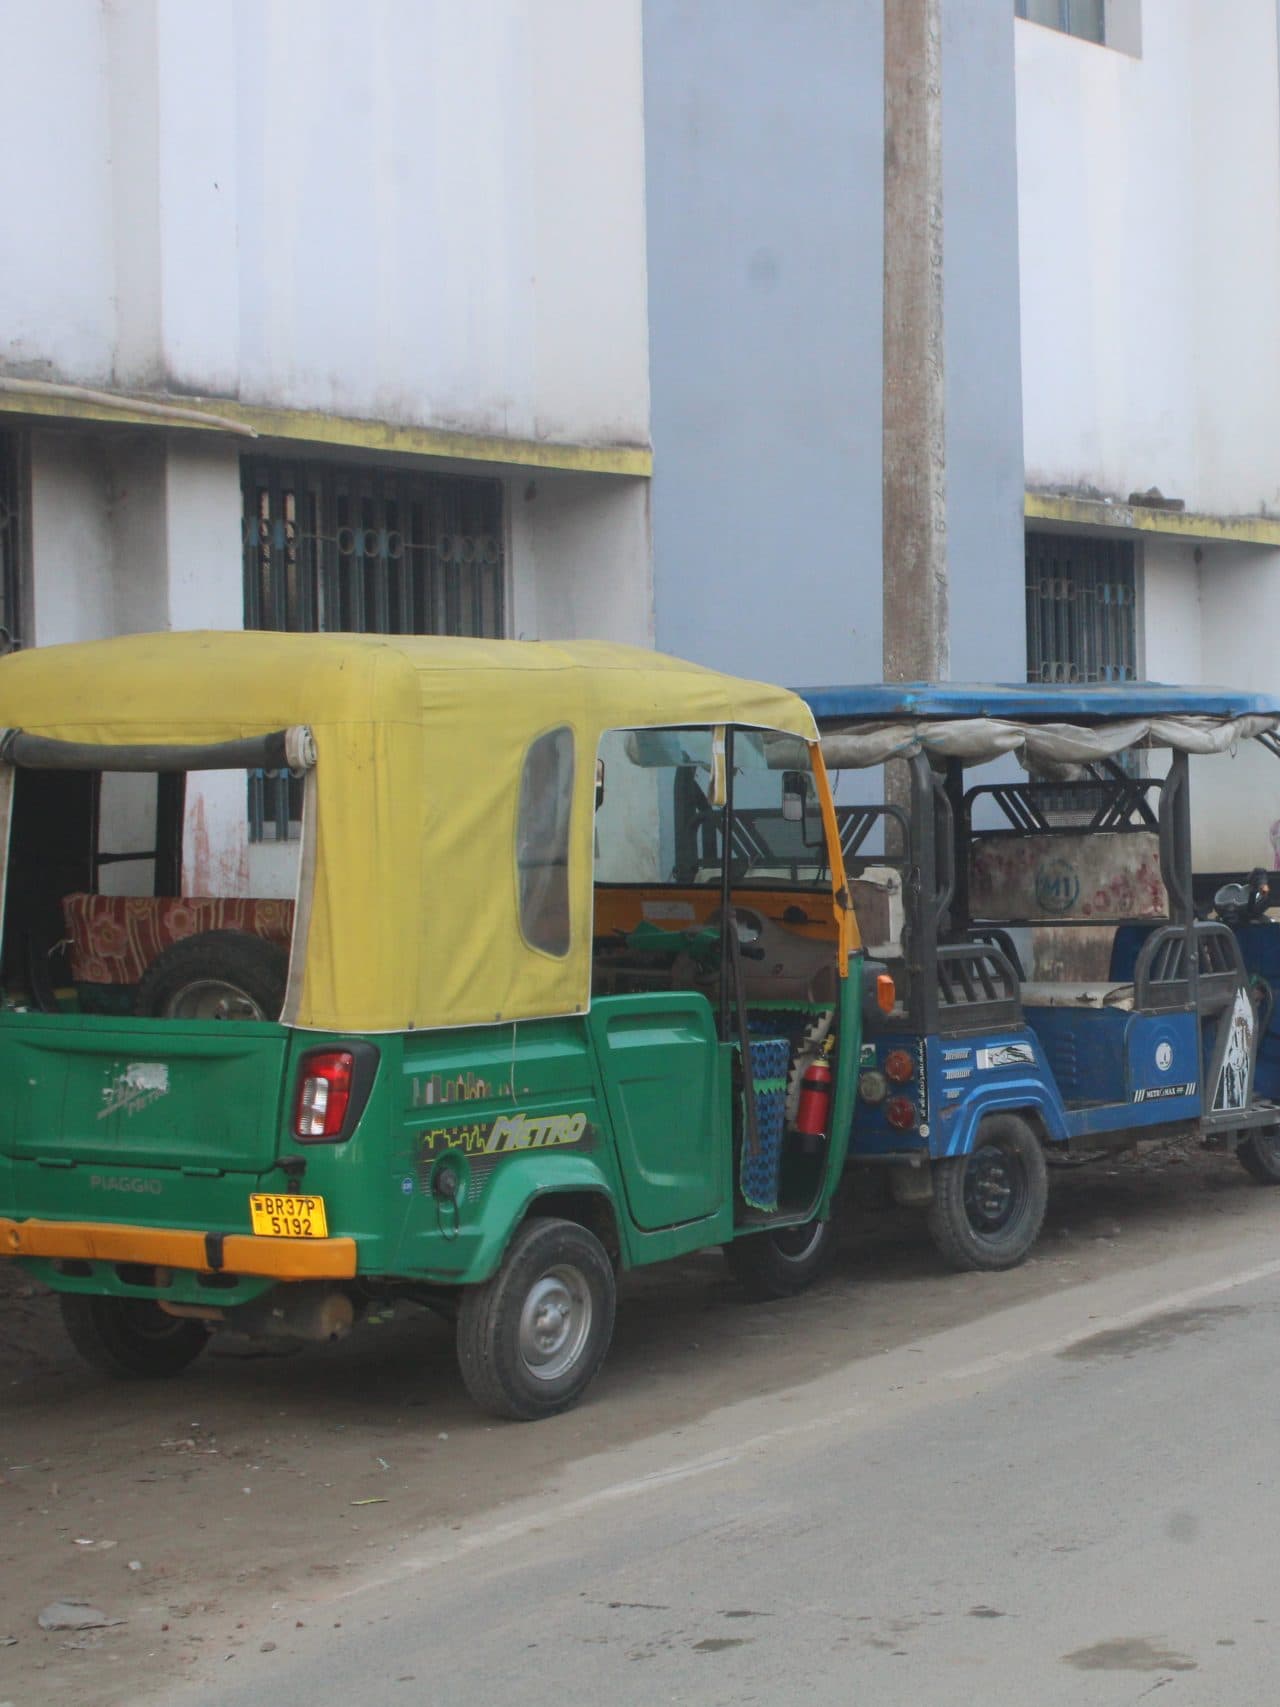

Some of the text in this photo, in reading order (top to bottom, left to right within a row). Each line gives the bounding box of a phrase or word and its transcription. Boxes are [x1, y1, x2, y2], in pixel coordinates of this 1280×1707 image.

[484, 1112, 587, 1152] METRO
[90, 1175, 162, 1194] PIAGGIO
[265, 1197, 315, 1217] BR37P
[272, 1217, 313, 1236] 5192
